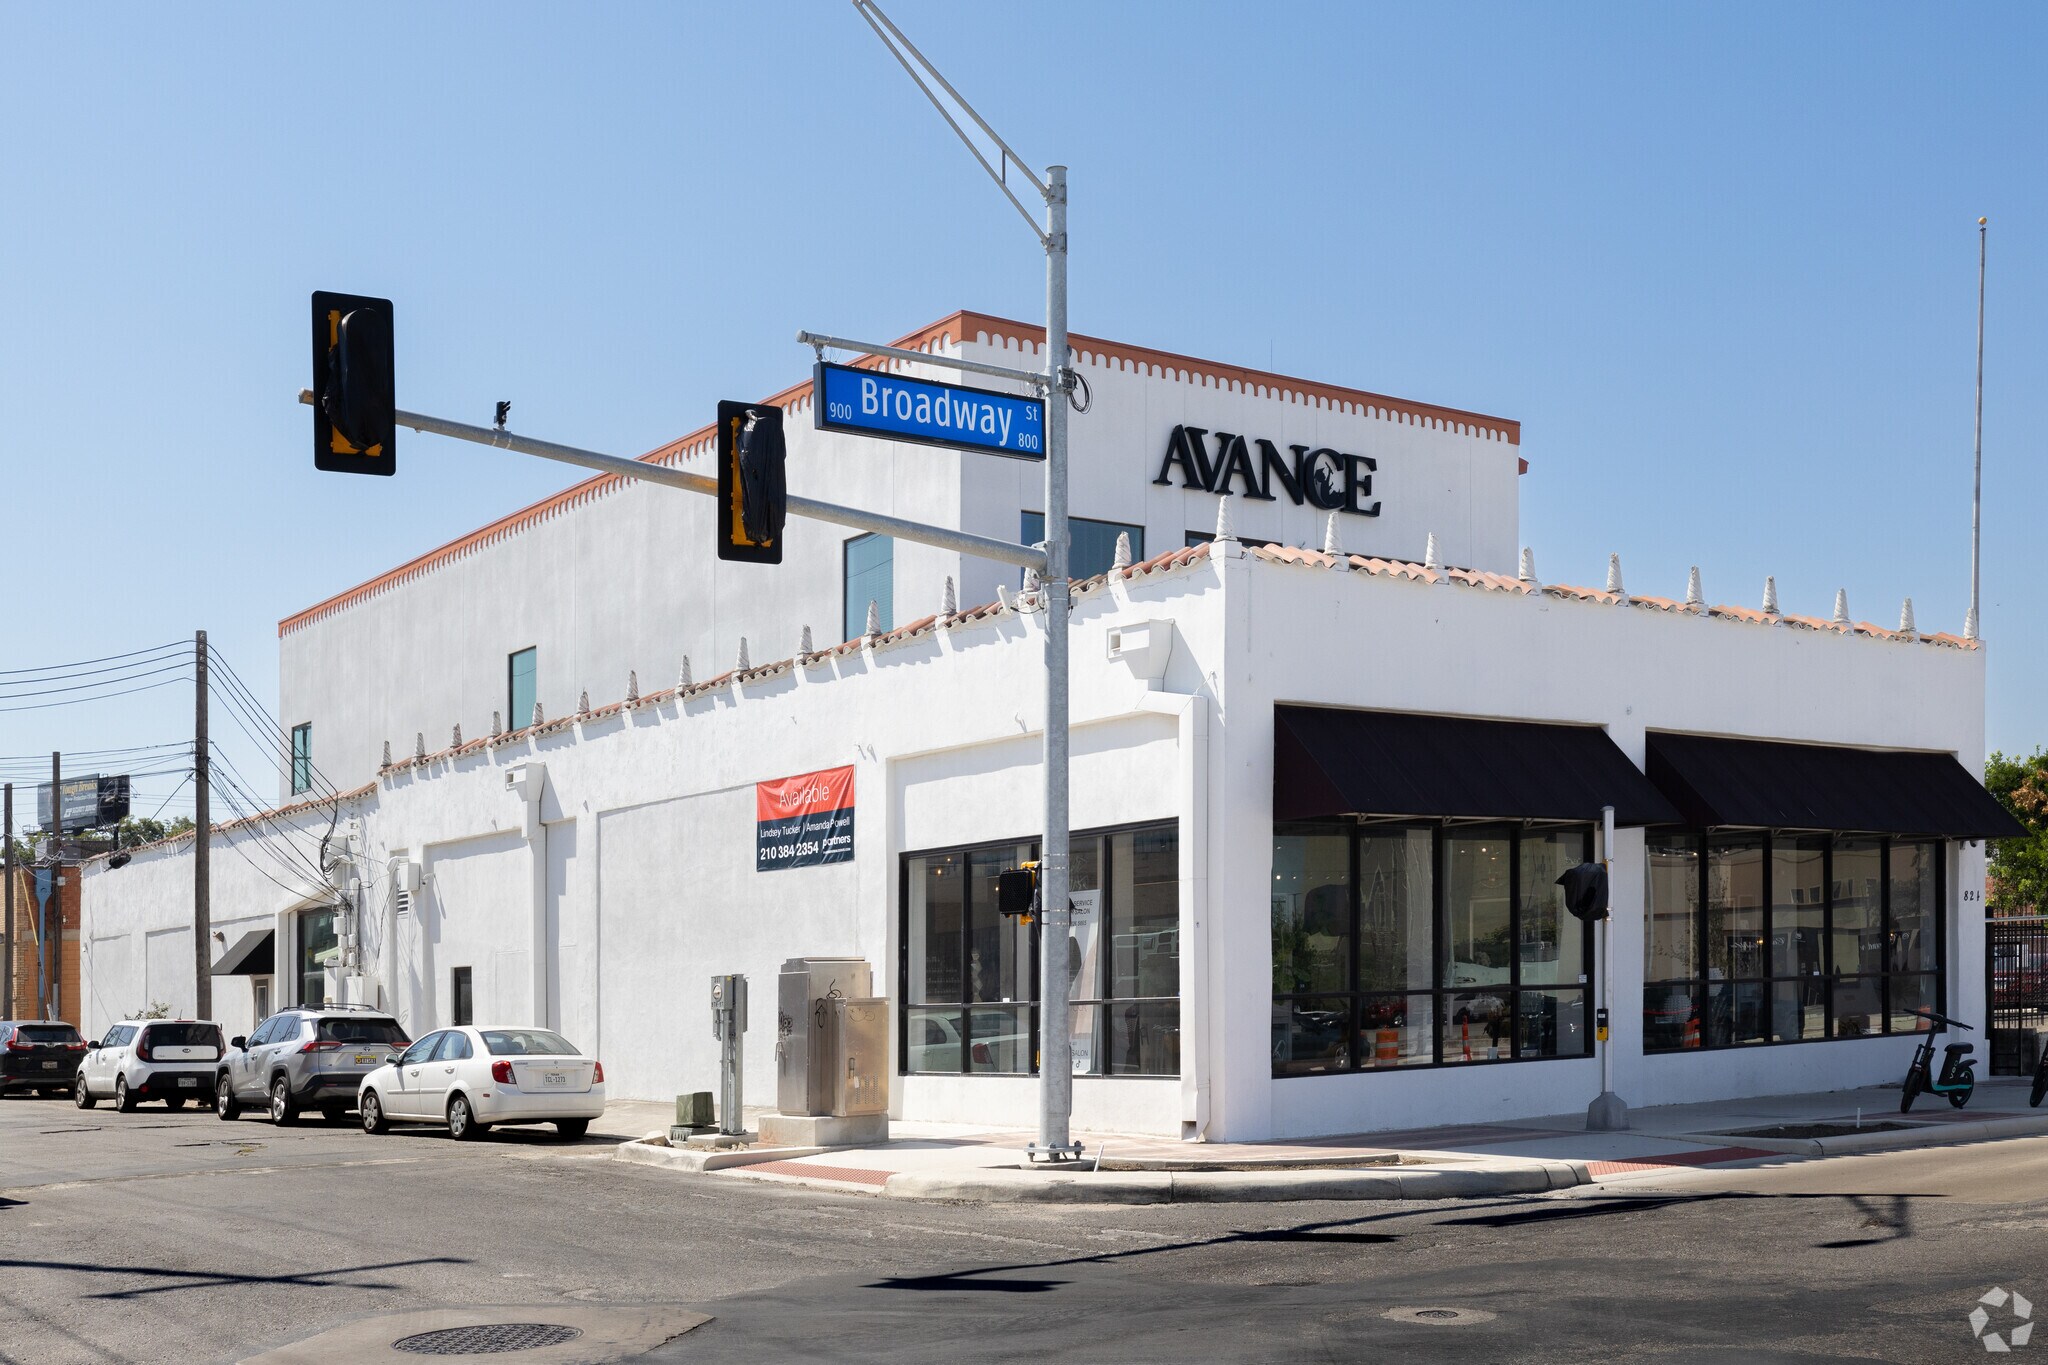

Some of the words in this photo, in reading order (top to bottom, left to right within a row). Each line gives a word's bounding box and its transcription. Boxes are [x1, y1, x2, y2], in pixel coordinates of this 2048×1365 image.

[830, 402, 852, 420] 900
[861, 378, 1012, 446] Broadway
[1025, 406, 1038, 421] St
[1018, 433, 1038, 449] 800
[1153, 424, 1381, 517] AVANCE
[780, 783, 830, 808] Available
[760, 829, 781, 838] Lindsey
[782, 825, 801, 836] Tucker
[806, 820, 829, 832] Amanda
[829, 816, 850, 828] Powell
[760, 847, 777, 860] 210
[778, 844, 795, 858] 384
[796, 841, 819, 856] 2354
[822, 835, 851, 849] partners
